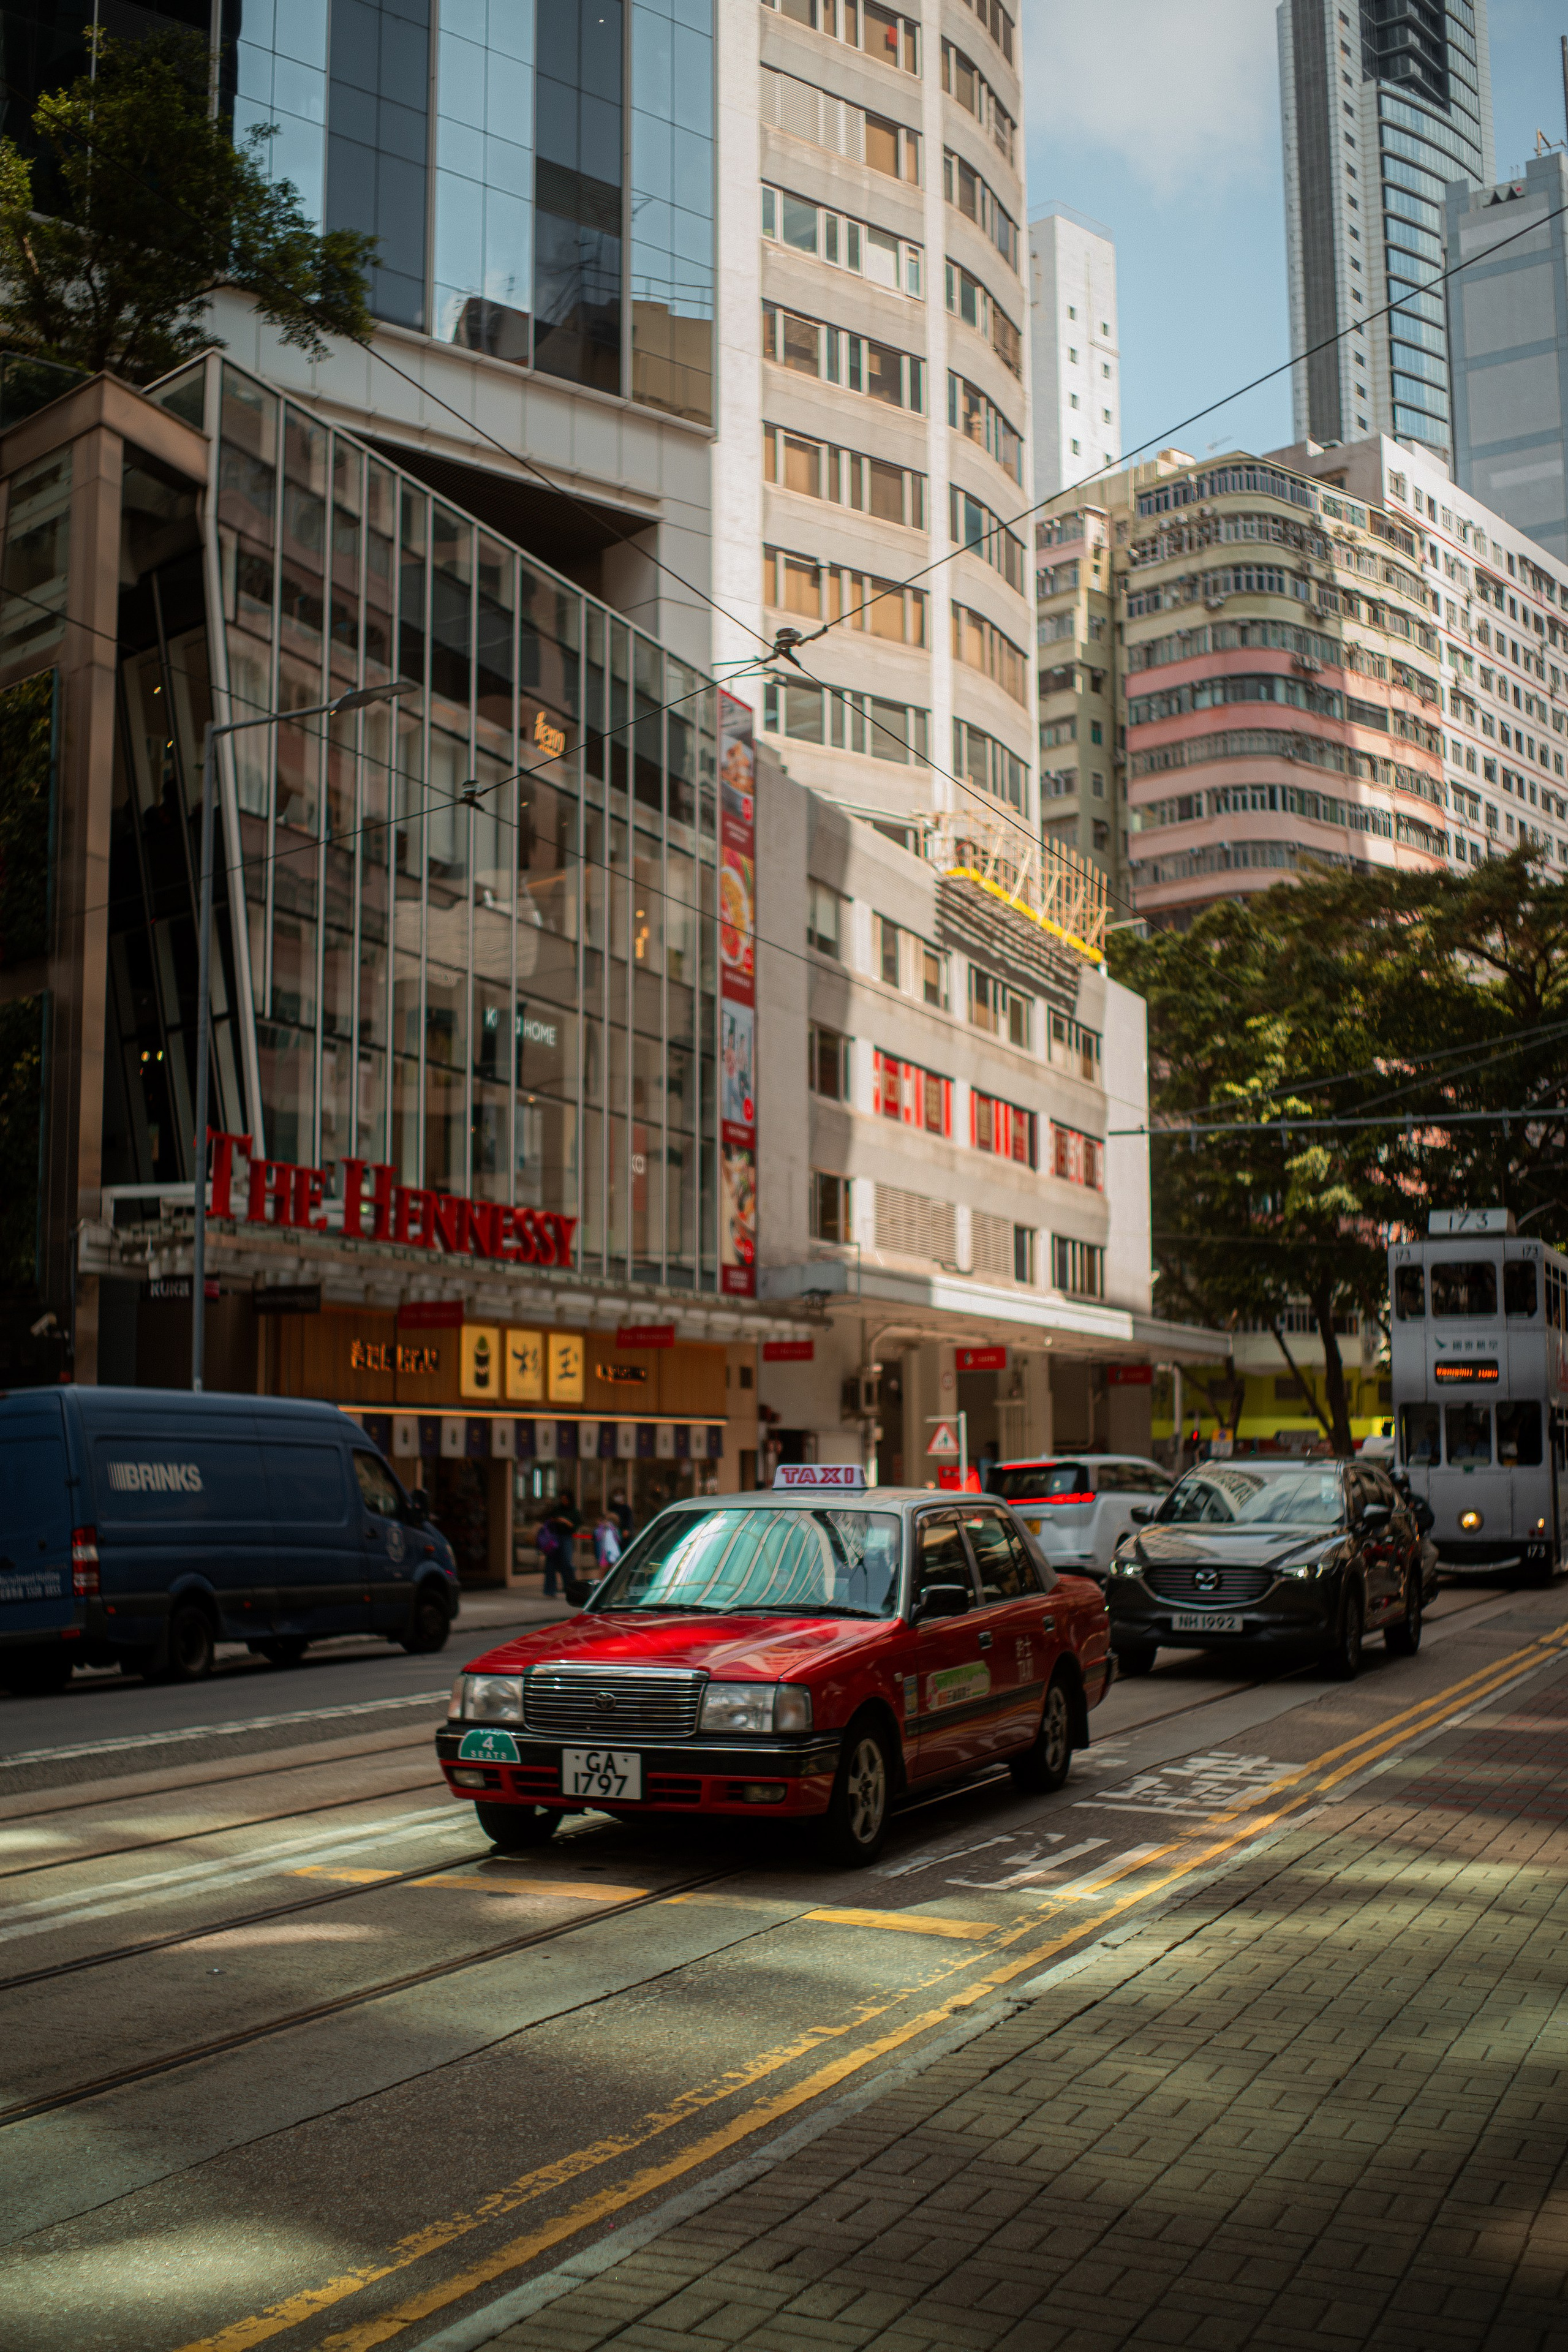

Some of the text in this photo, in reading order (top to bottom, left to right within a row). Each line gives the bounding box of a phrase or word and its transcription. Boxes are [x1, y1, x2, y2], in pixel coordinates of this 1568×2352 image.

[524, 1019, 556, 1045] HOME
[194, 1125, 579, 1268] THE HENNESSY
[1448, 1213, 1489, 1230] 173
[123, 1462, 203, 1492] BRINKS
[782, 1467, 854, 1484] TAXI
[1178, 1615, 1235, 1629] NH 1992
[482, 1736, 494, 1750] 4
[470, 1750, 507, 1760] SEATS
[586, 1752, 616, 1774] GA
[573, 1772, 628, 1796] 1797
